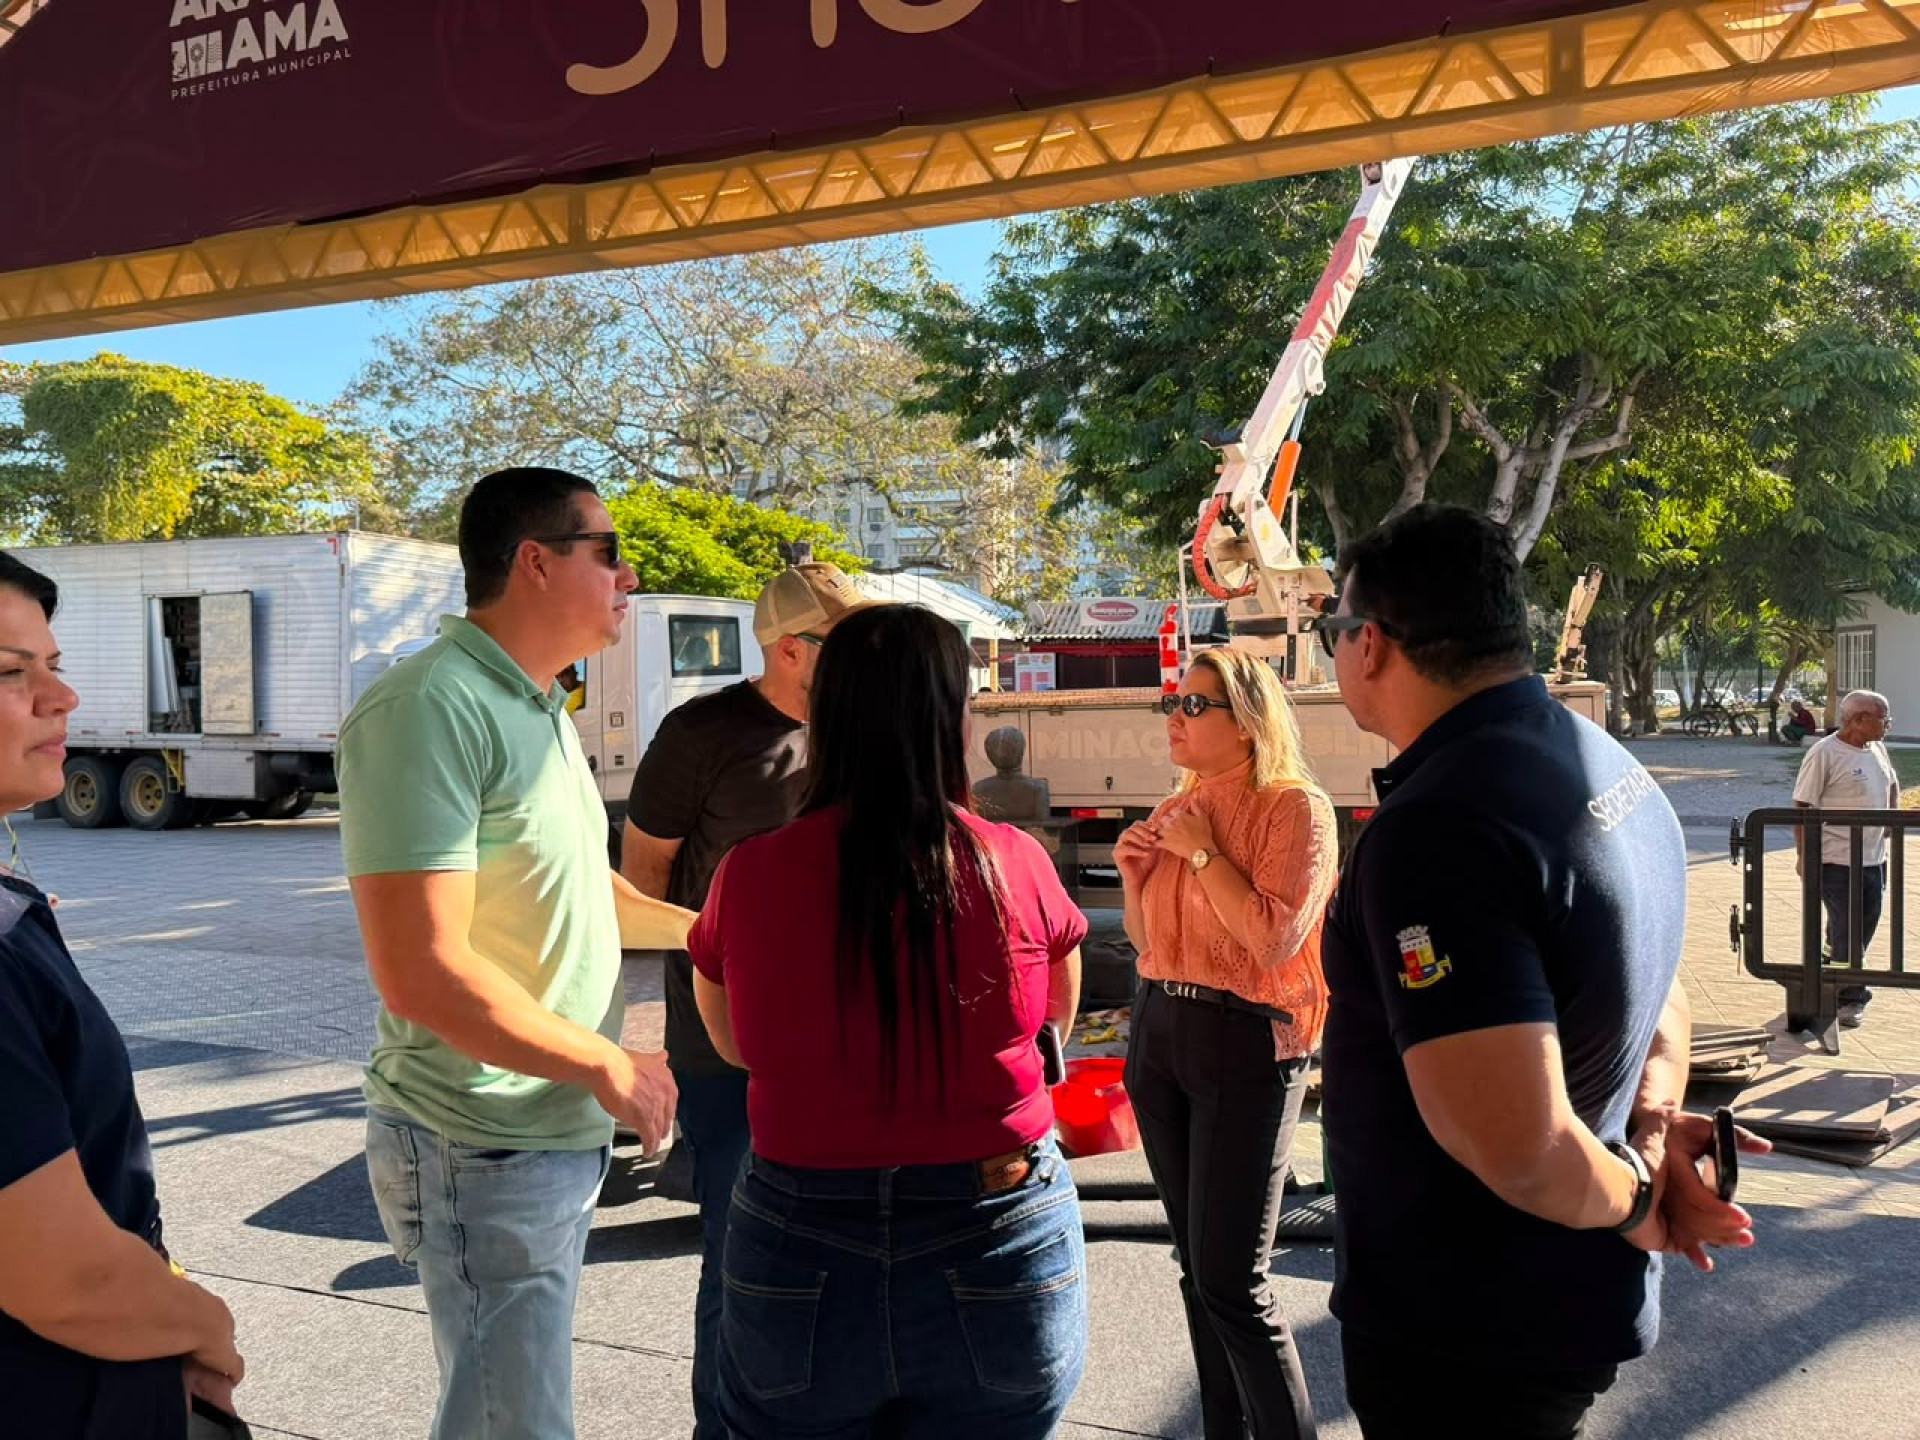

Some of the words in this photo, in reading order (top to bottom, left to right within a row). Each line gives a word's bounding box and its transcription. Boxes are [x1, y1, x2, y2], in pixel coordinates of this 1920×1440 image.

[225, 0, 349, 70] AMA
[171, 70, 260, 100] PREFEITURA
[267, 48, 351, 76] MUNICIPAL
